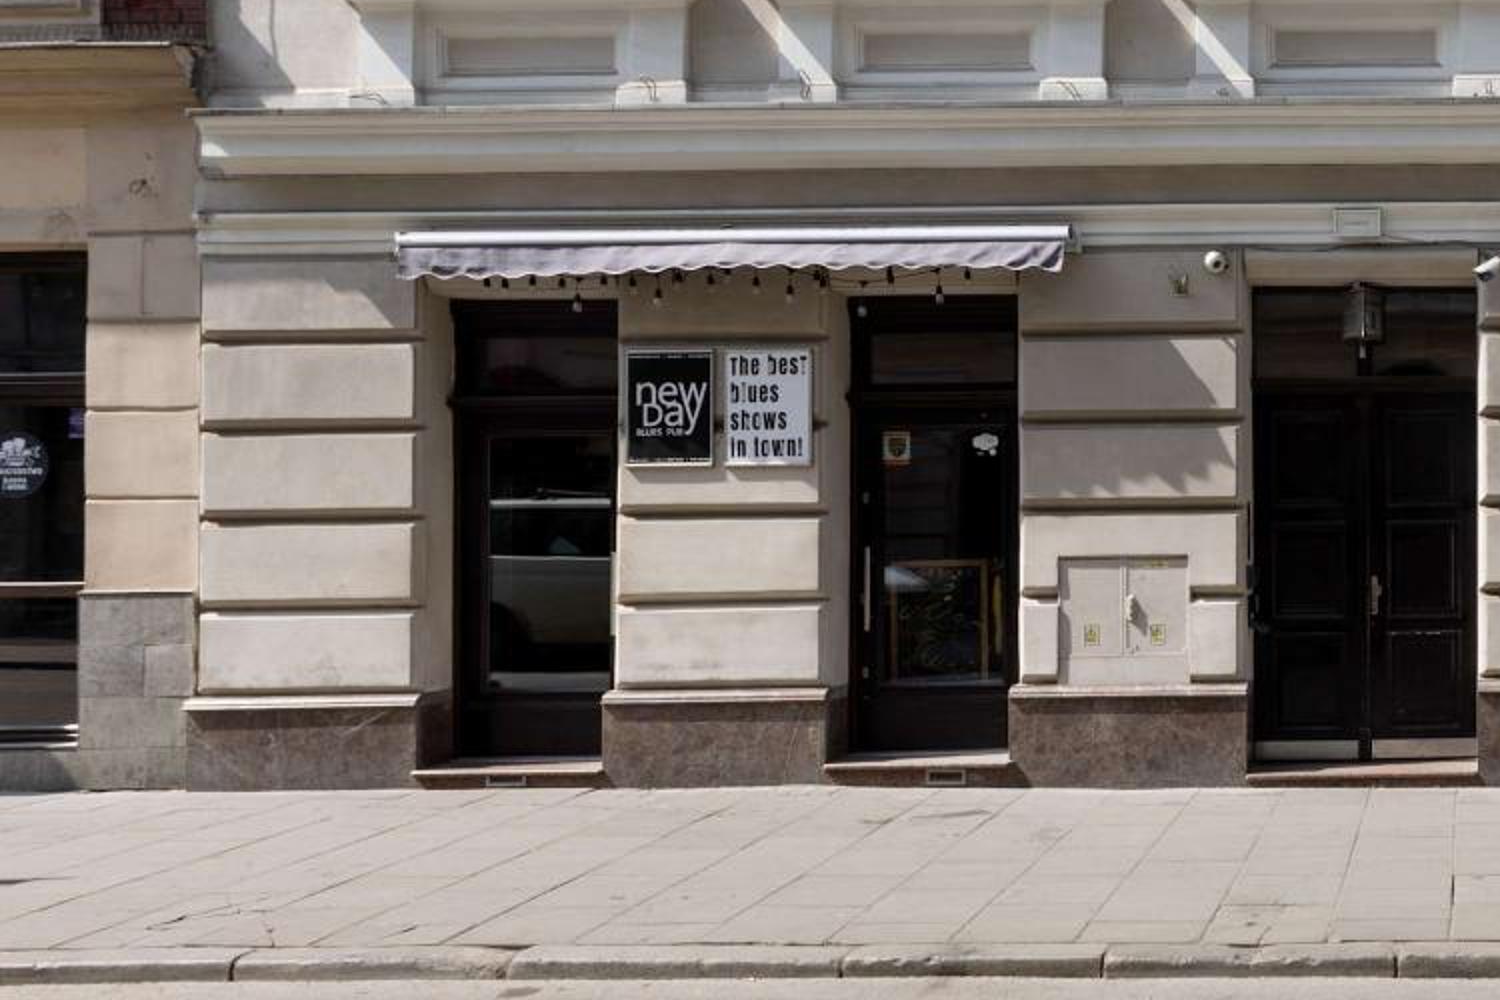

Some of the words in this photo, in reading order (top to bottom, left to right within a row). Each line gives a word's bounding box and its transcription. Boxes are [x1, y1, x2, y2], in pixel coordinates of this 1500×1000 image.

[730, 355, 759, 376] The
[635, 381, 707, 406] new
[730, 382, 779, 403] blues
[730, 409, 787, 430] shows
[636, 427, 663, 437] BLUES
[666, 427, 684, 437] PUB
